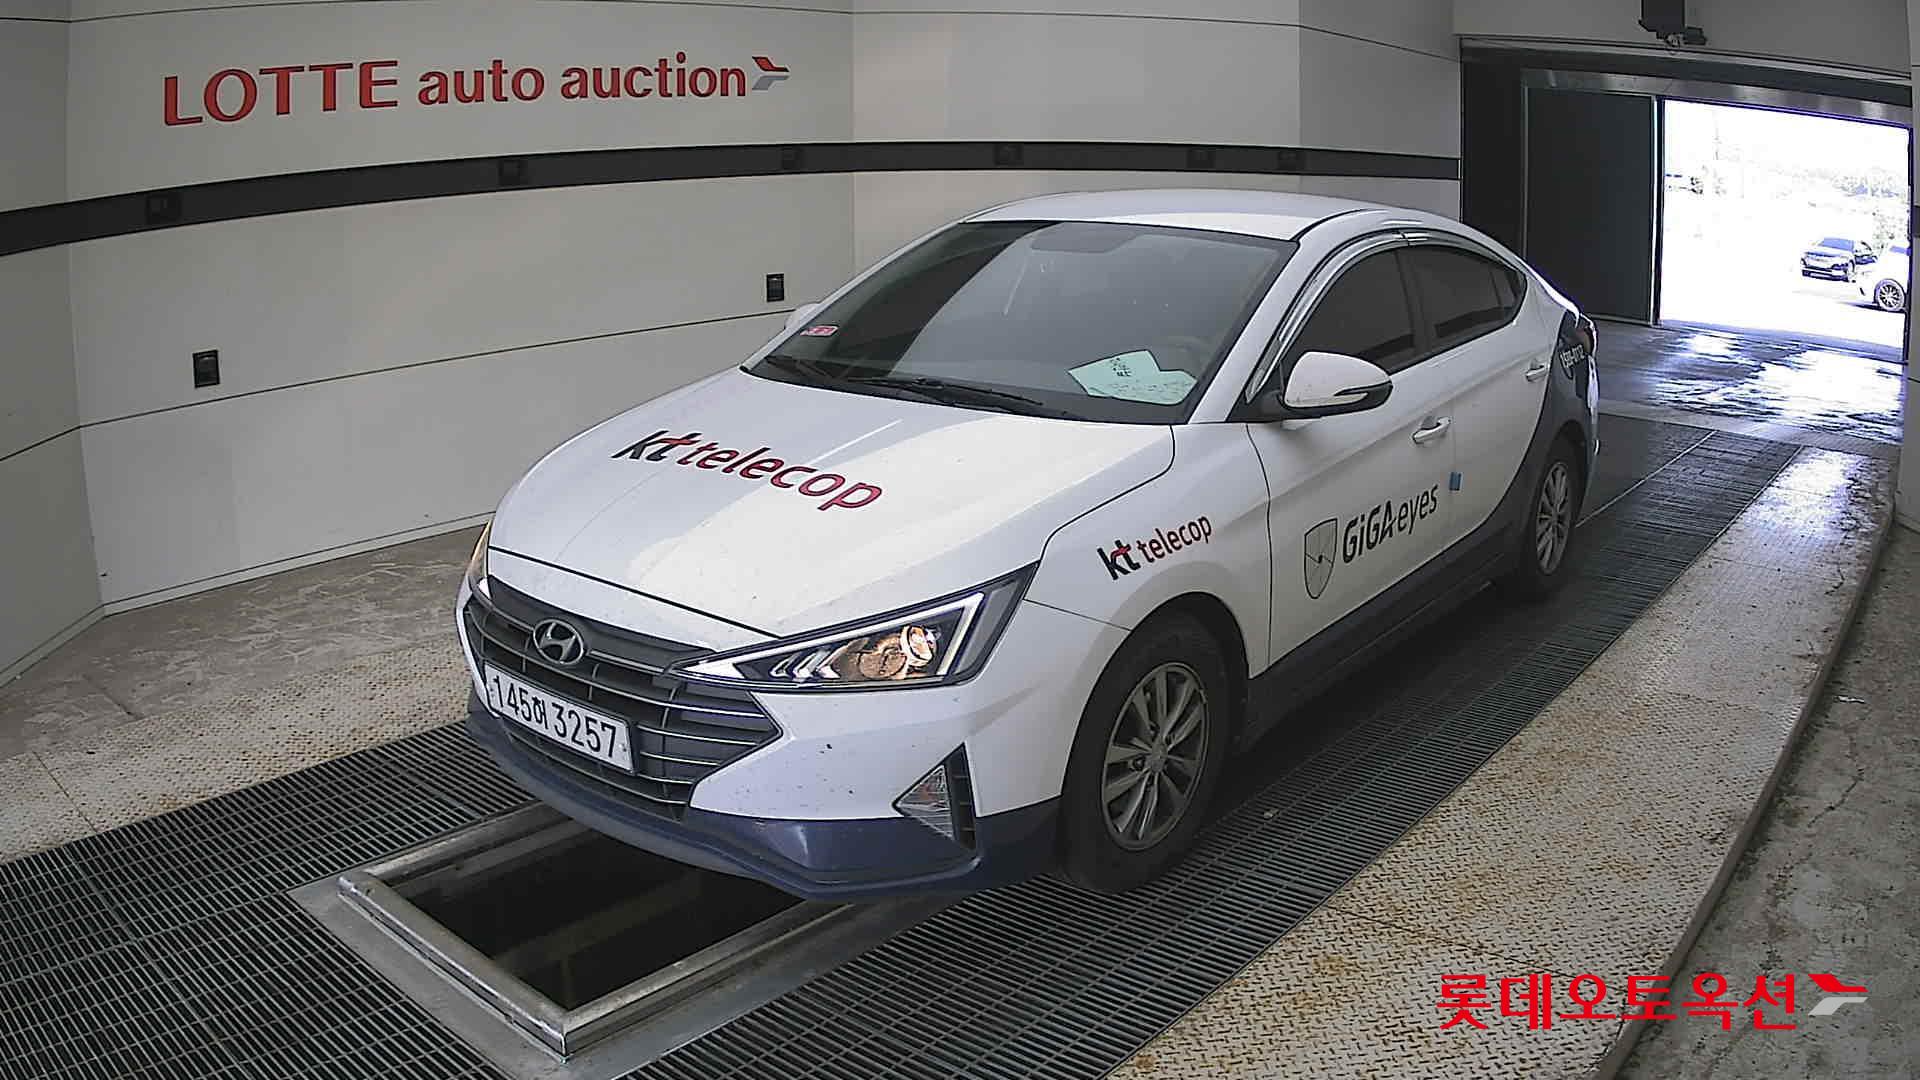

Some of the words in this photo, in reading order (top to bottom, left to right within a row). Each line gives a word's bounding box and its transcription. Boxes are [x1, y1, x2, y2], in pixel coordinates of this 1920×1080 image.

[164, 60, 398, 126] LOTTE
[417, 59, 545, 106] auto
[560, 51, 748, 99] auction
[611, 430, 702, 462] kt
[676, 442, 882, 511] telecop
[1097, 540, 1141, 580] kt
[1136, 515, 1212, 564] telecop
[551, 701, 617, 758] 3257
